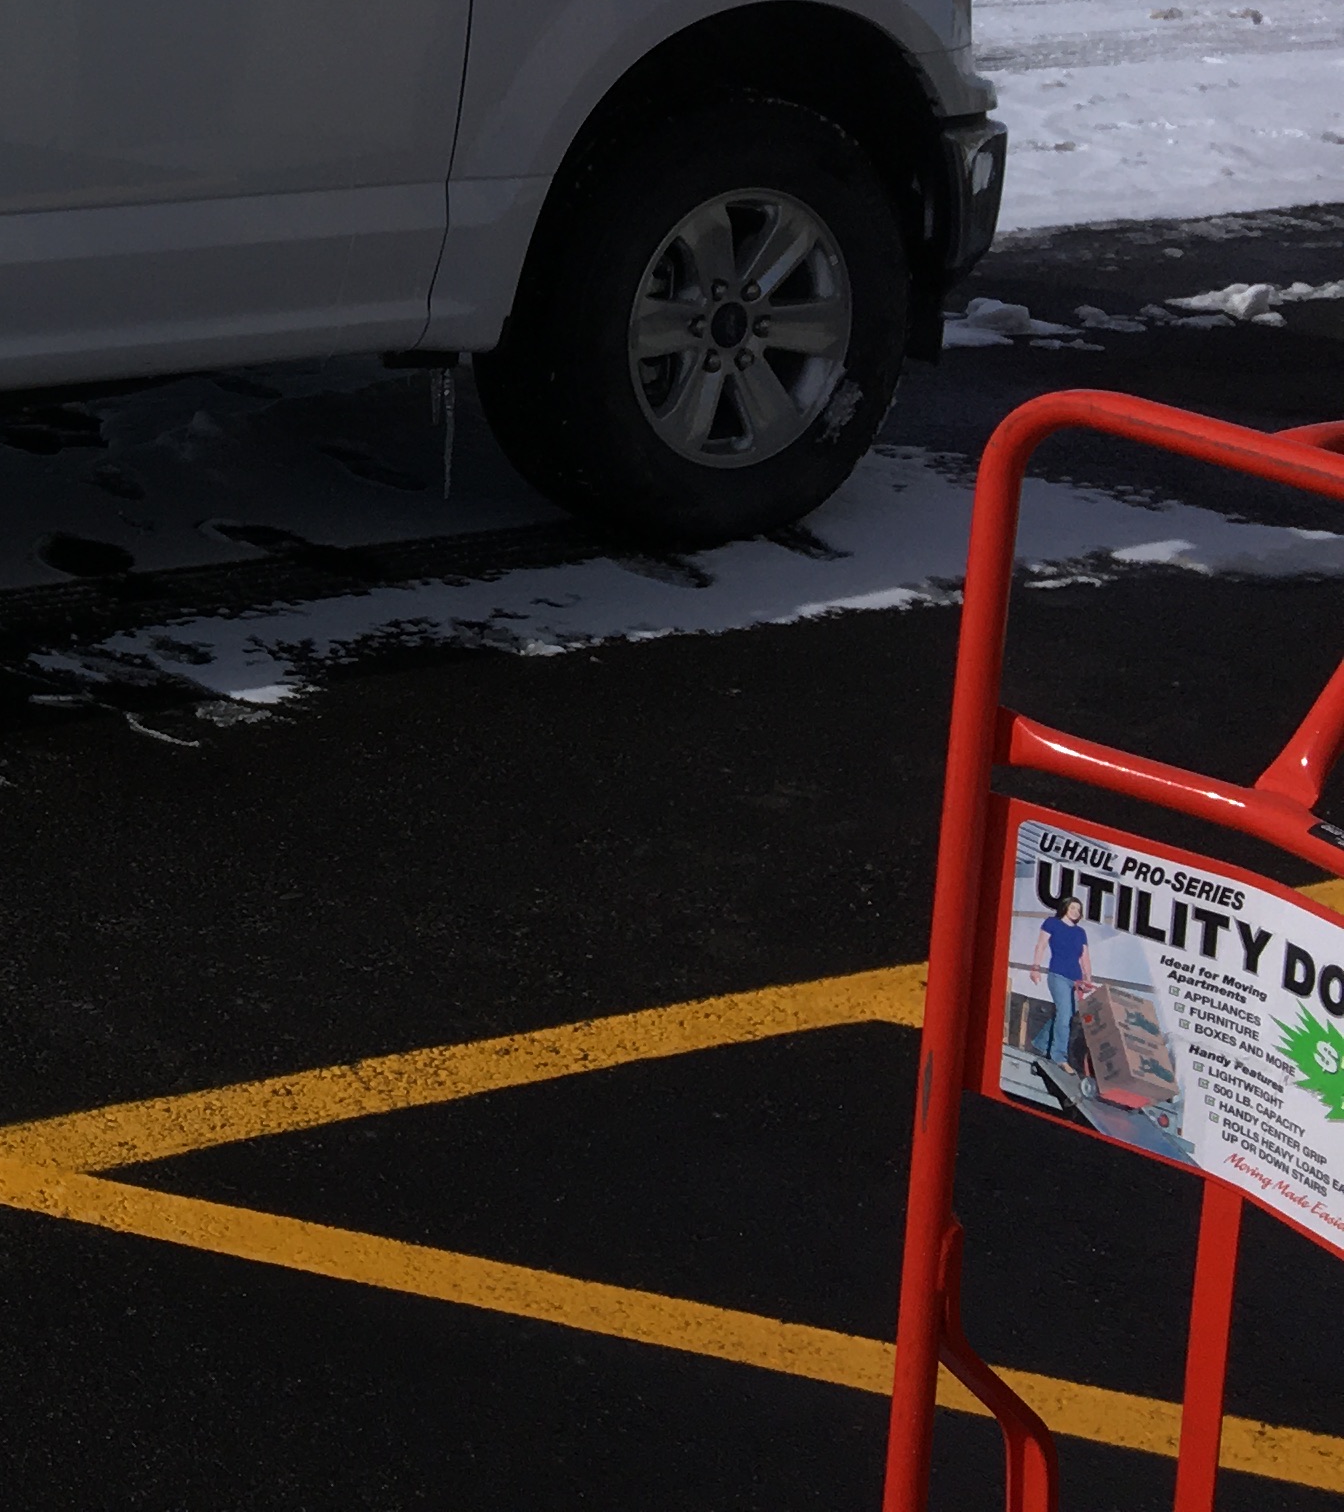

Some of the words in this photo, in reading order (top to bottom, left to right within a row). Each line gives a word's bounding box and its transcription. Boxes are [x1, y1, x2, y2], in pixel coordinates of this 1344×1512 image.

[1039, 832, 1115, 871] U-HAUL
[1121, 856, 1246, 911] PRO-SERIES
[1036, 858, 1274, 976] UTILITY
[1160, 954, 1195, 974] Ideal
[1199, 967, 1220, 982] for
[1221, 975, 1268, 1002] Moving
[1167, 970, 1248, 1005] Apartments
[1184, 991, 1262, 1027] APPLIANCES
[1189, 1007, 1261, 1042] FURNITURE
[1189, 1044, 1232, 1067] Handy
[1233, 1059, 1285, 1094] Features
[1194, 1023, 1238, 1047] BOXES
[1238, 1041, 1265, 1059] AND
[1265, 1052, 1297, 1078] MORE
[1208, 1066, 1285, 1110] LIGHTWEIGHT
[1213, 1083, 1234, 1100] 500
[1236, 1093, 1255, 1110] LB.
[1256, 1102, 1307, 1138] CAPACITY
[1218, 1100, 1260, 1126] HANDY
[1261, 1121, 1301, 1153] CENTER
[1302, 1145, 1328, 1166] GRIP
[1223, 1117, 1260, 1143] ROLLS
[1261, 1139, 1294, 1163] HEAVY
[1296, 1156, 1331, 1186] LOADS
[1221, 1130, 1239, 1144] UP
[1240, 1139, 1258, 1155] OR
[1258, 1148, 1290, 1175] DOWN
[1291, 1168, 1328, 1198] STAIRS
[1223, 1153, 1273, 1190] Moving
[1273, 1180, 1311, 1208] Made
